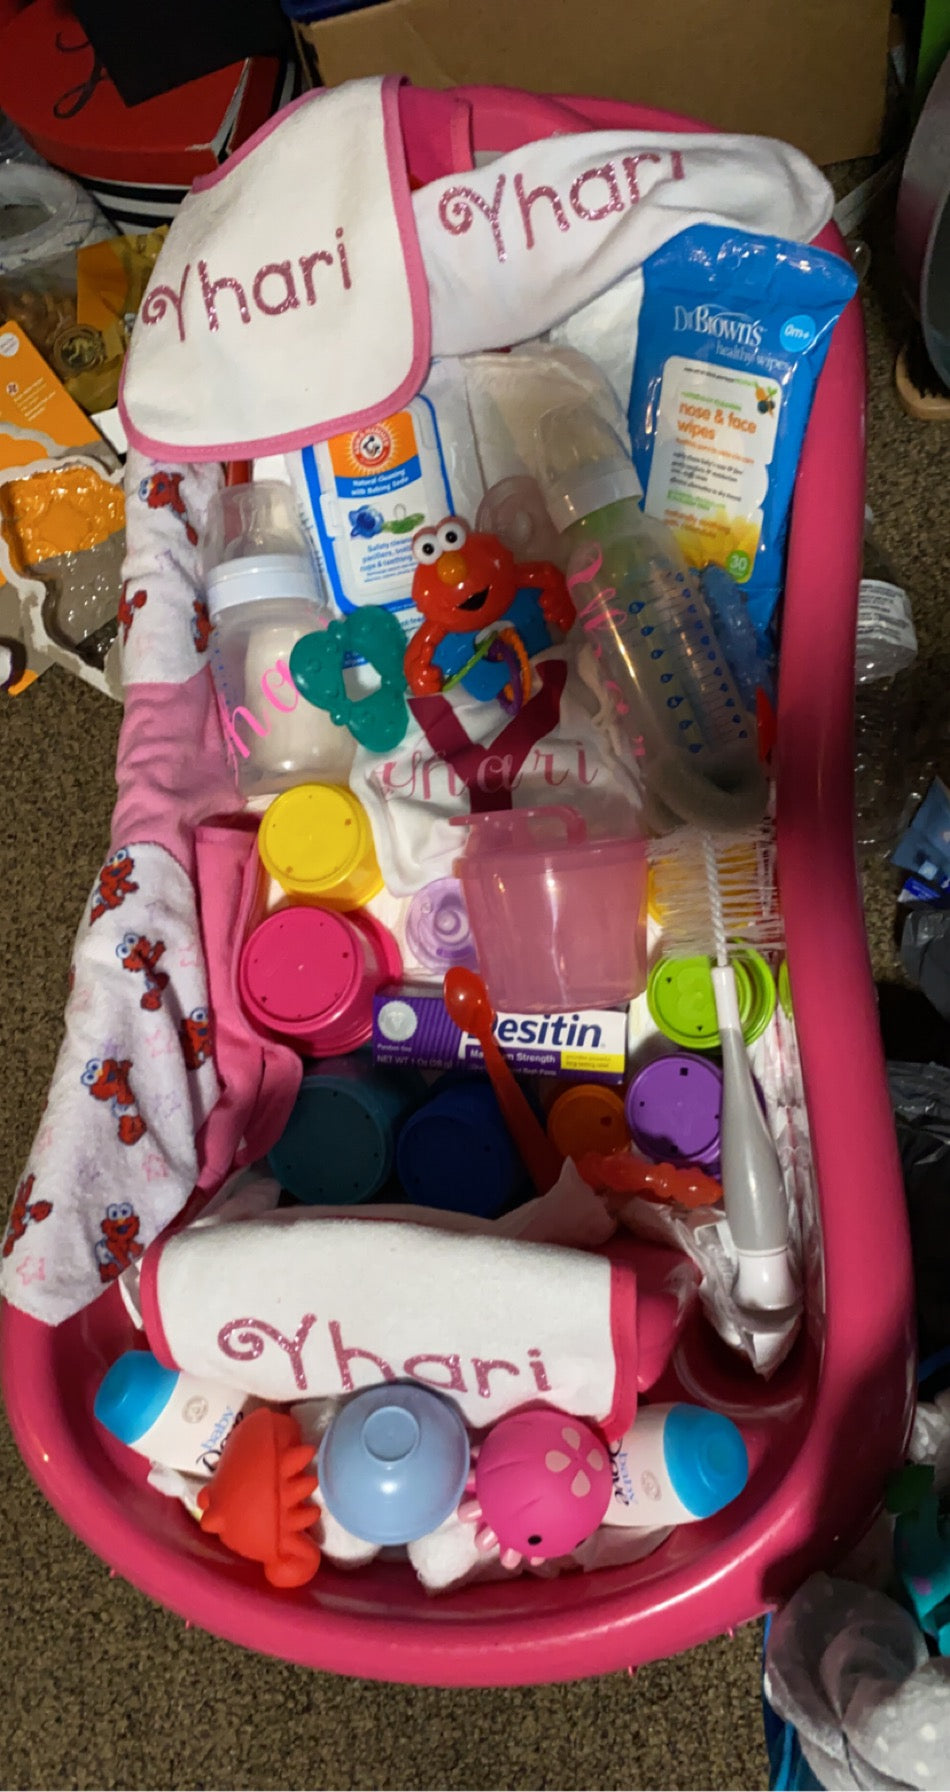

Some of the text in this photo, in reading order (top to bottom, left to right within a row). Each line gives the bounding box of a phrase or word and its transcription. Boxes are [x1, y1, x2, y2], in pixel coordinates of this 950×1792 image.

[438, 150, 685, 263] Yhari
[142, 227, 352, 342] Yhari
[677, 420, 715, 440] wipes
[679, 403, 757, 434] nose & face
[729, 554, 749, 571] 30
[377, 1055, 392, 1064] NET
[395, 1056, 408, 1064] WT
[516, 1051, 556, 1064] Strength
[217, 1313, 552, 1398] Yhari
